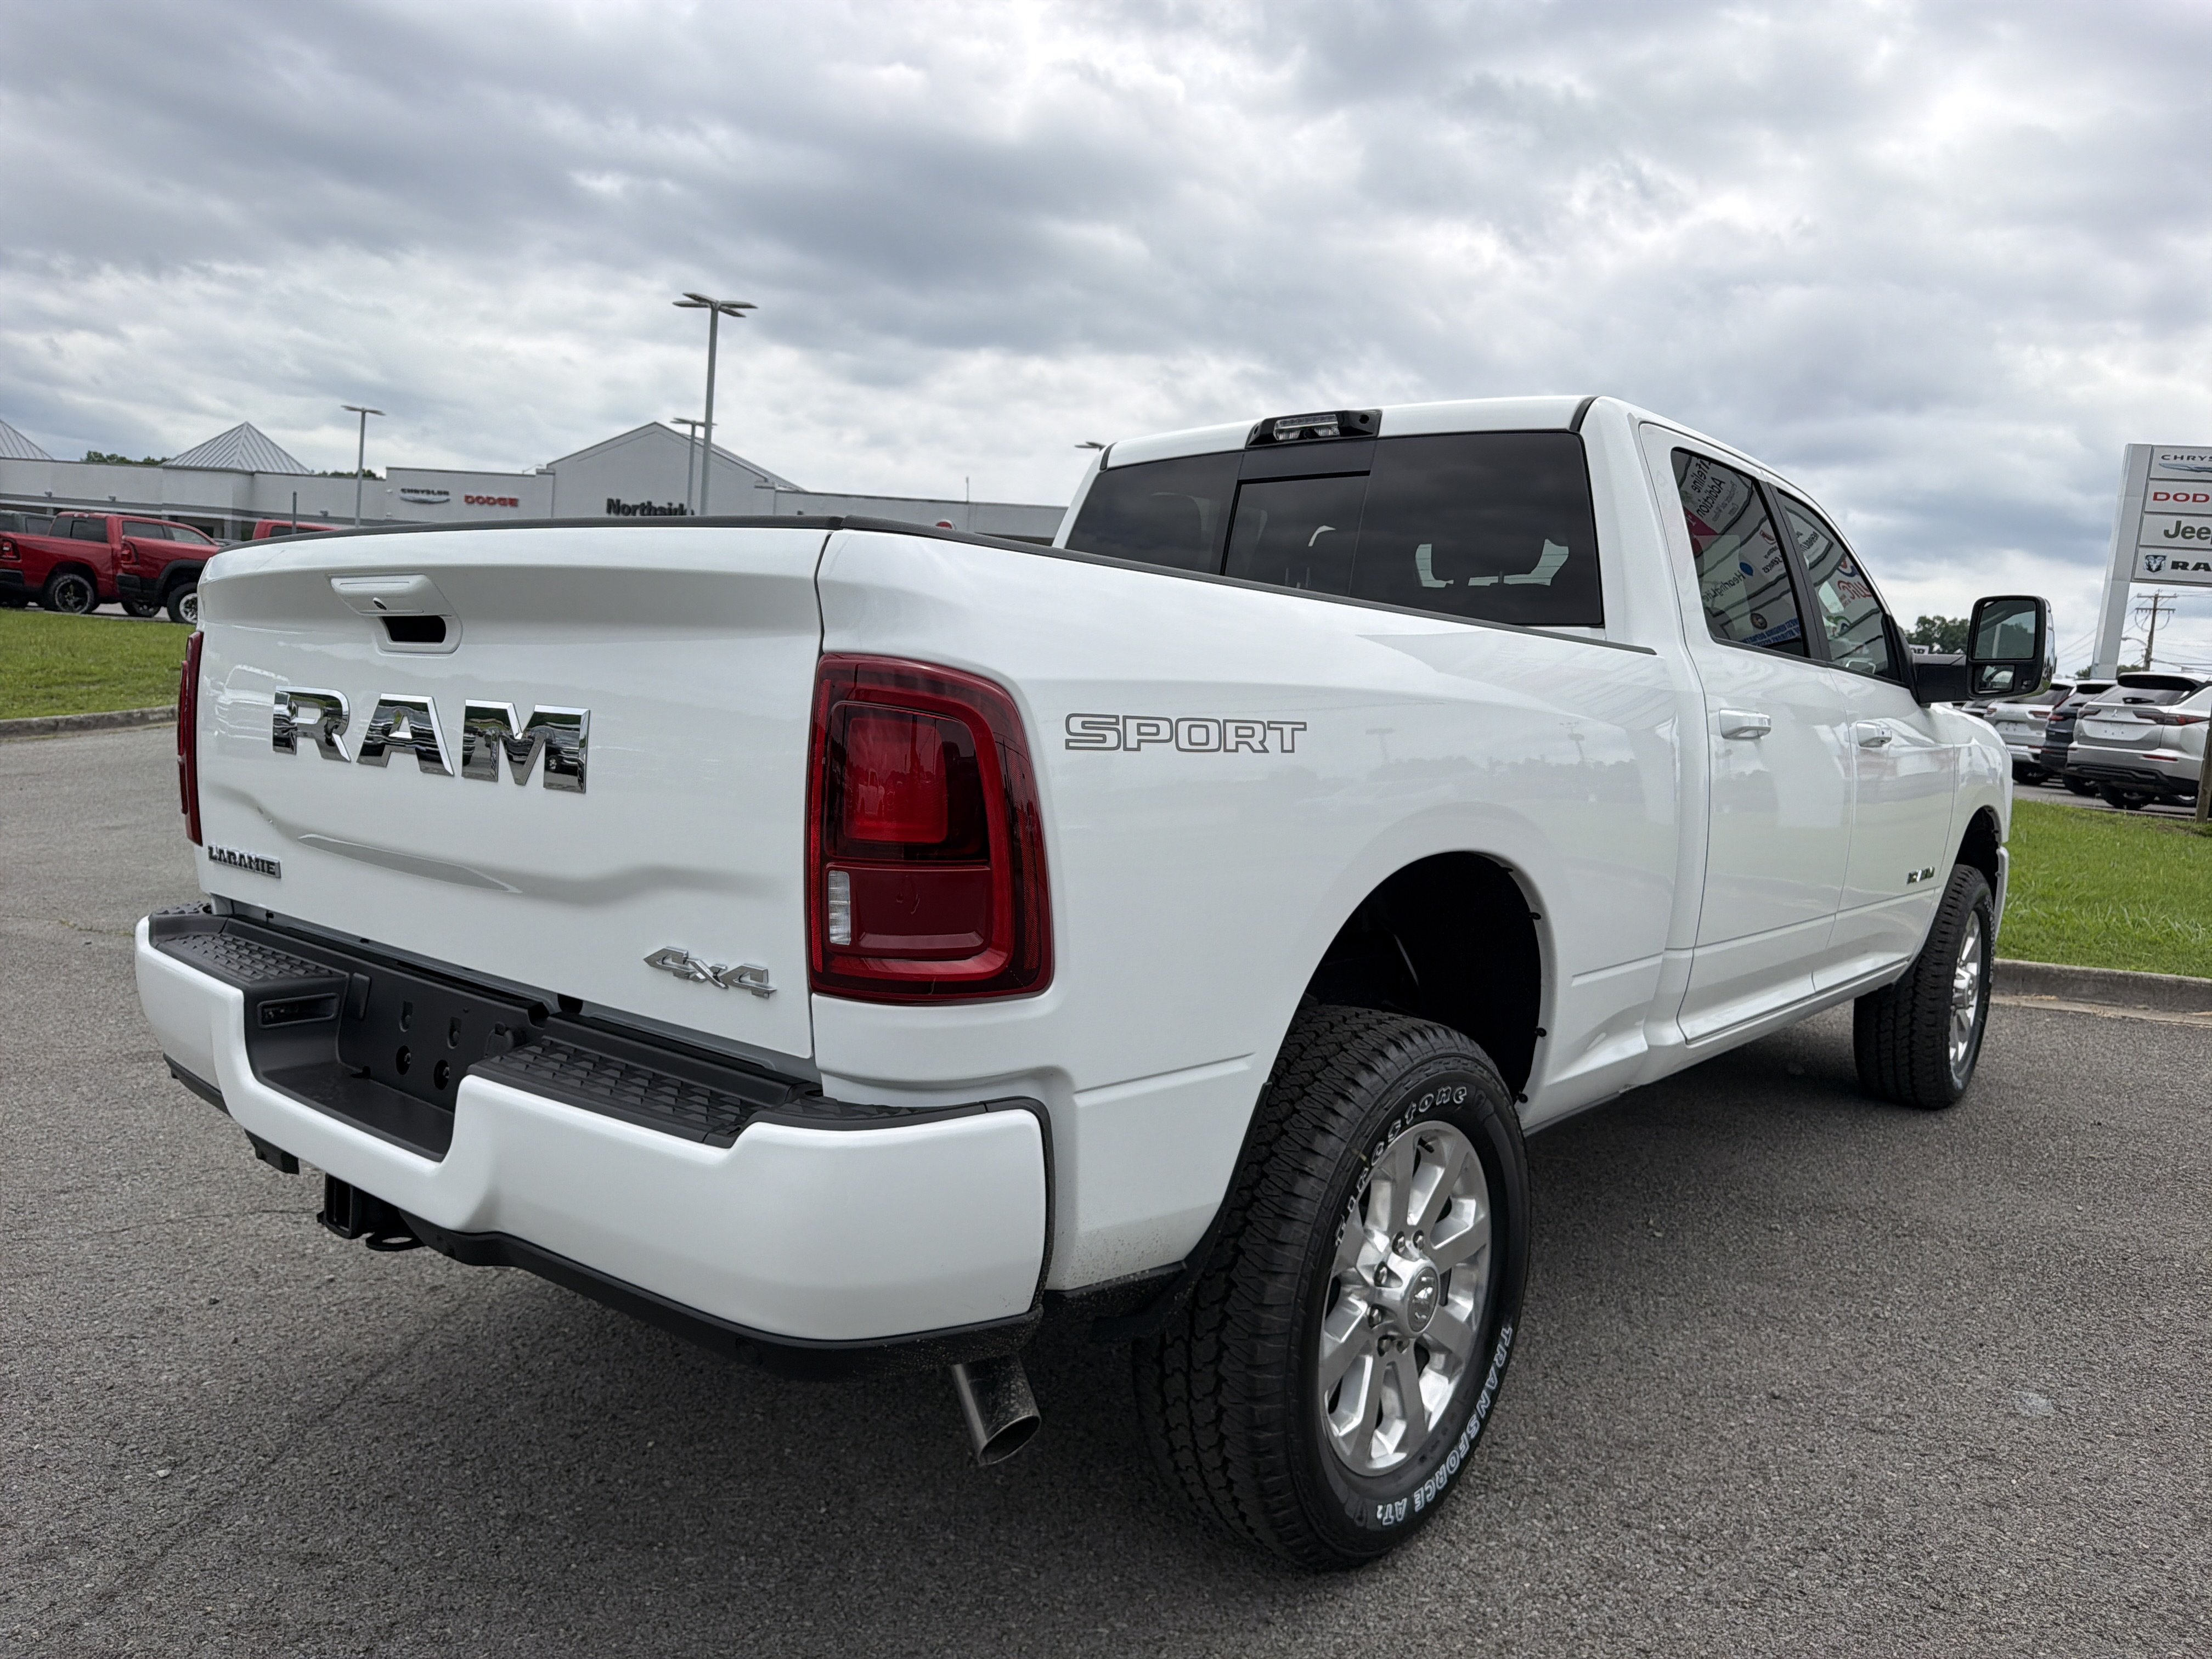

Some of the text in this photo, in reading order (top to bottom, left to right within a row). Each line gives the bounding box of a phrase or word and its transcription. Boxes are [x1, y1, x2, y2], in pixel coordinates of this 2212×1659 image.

[464, 494, 518, 507] DODGE
[2163, 520, 2212, 545] Jee
[272, 685, 591, 793] RAM
[1065, 713, 1307, 753] SPORT
[208, 845, 279, 877] LARAMIE
[1413, 1325, 1513, 1513] TRANSFORCE
